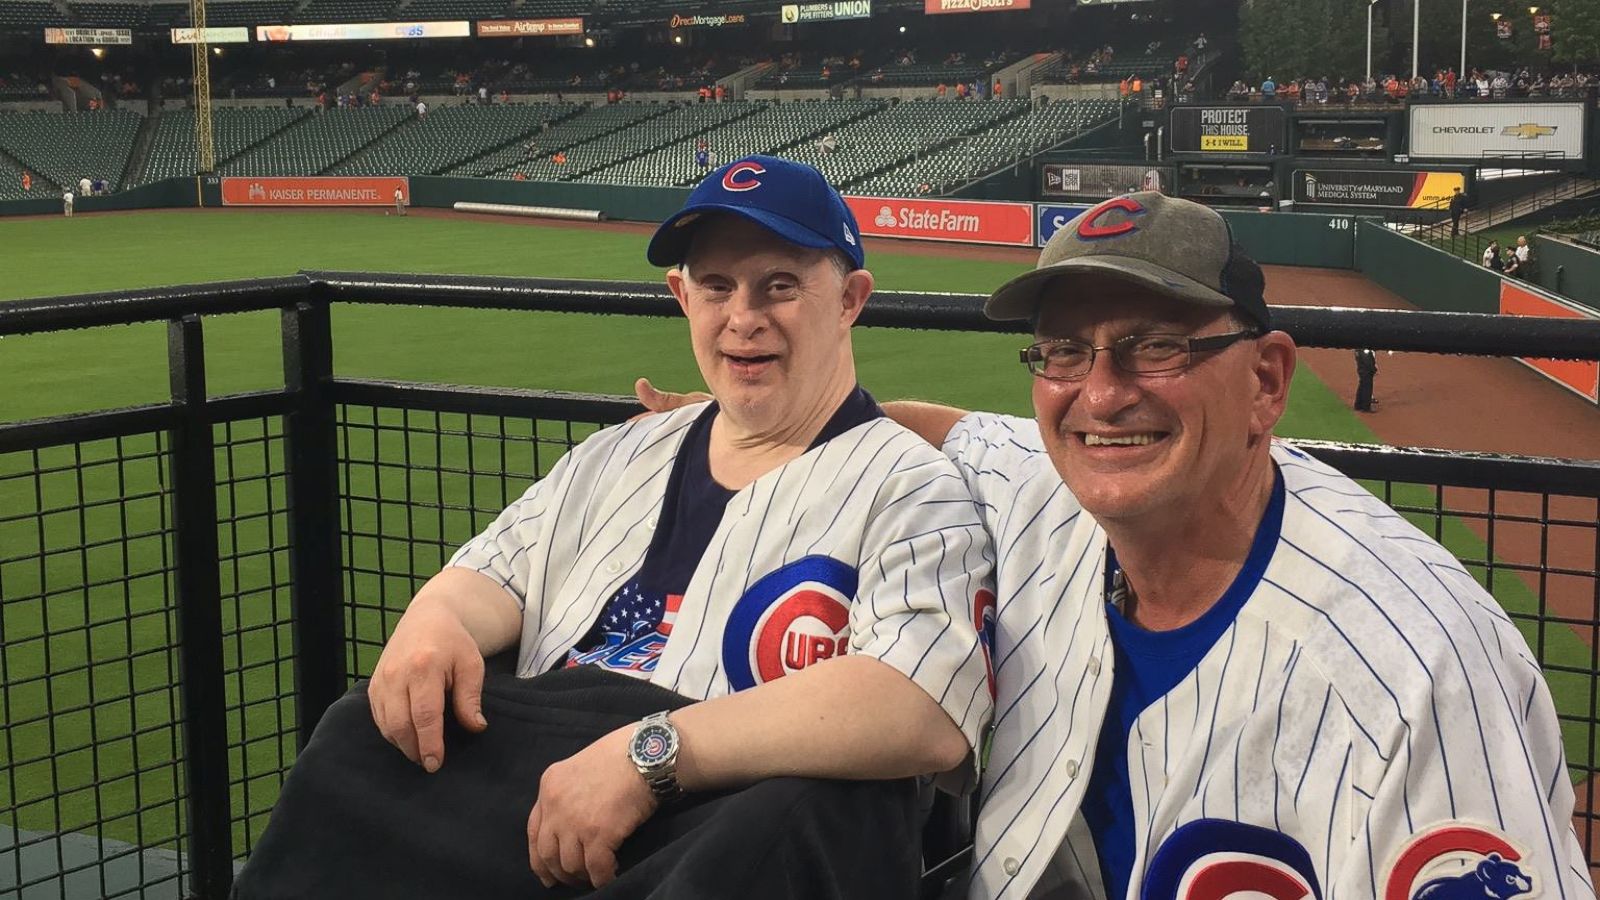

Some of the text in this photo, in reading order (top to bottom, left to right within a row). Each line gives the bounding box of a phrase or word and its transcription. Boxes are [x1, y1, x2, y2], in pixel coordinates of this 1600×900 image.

[800, 4, 828, 12] PLUMBERS
[835, 0, 870, 16] UNION
[514, 21, 545, 32] Airtemp
[1201, 109, 1248, 124] PROTECT
[1201, 124, 1219, 135] THIS
[1432, 126, 1495, 134] CHEVROLET
[722, 161, 766, 191] C
[1318, 183, 1358, 192] UNIVERSITY
[1364, 184, 1404, 194] MARYLAND
[269, 189, 304, 200] KAISER
[1318, 191, 1377, 200] MEDICAL SYSTEM
[1077, 197, 1145, 240] C
[1328, 218, 1349, 230] 410
